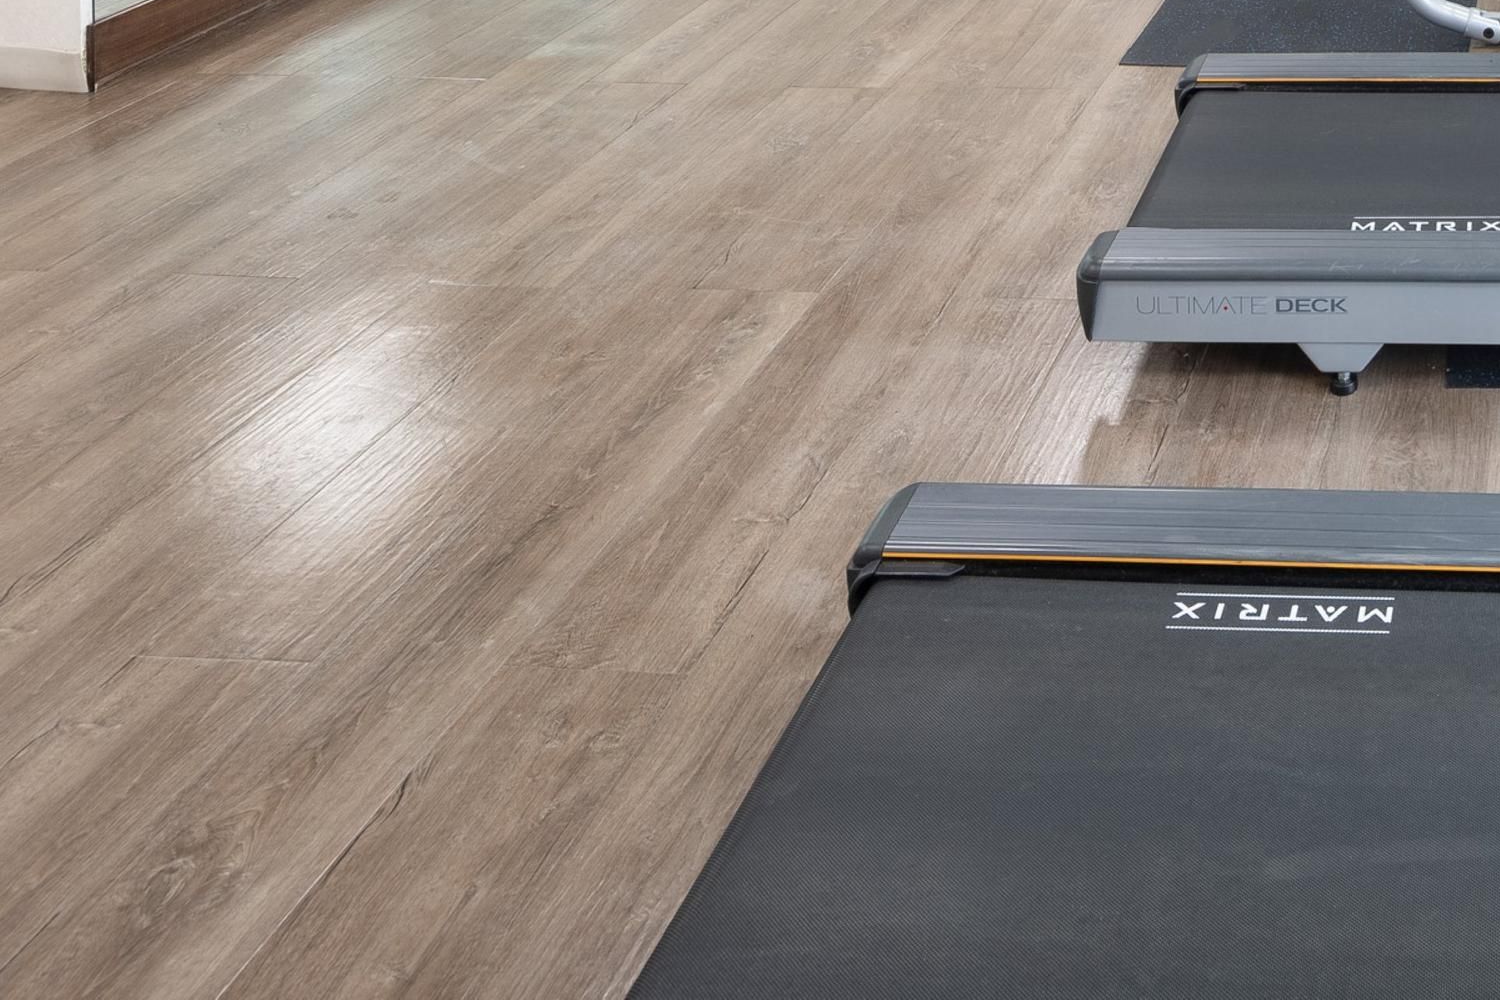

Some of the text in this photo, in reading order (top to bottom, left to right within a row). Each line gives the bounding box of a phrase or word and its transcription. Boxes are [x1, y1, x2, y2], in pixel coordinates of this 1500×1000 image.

[1136, 296, 1348, 315] ULTIMATE DECK
[1172, 601, 1394, 623] MATRIX
